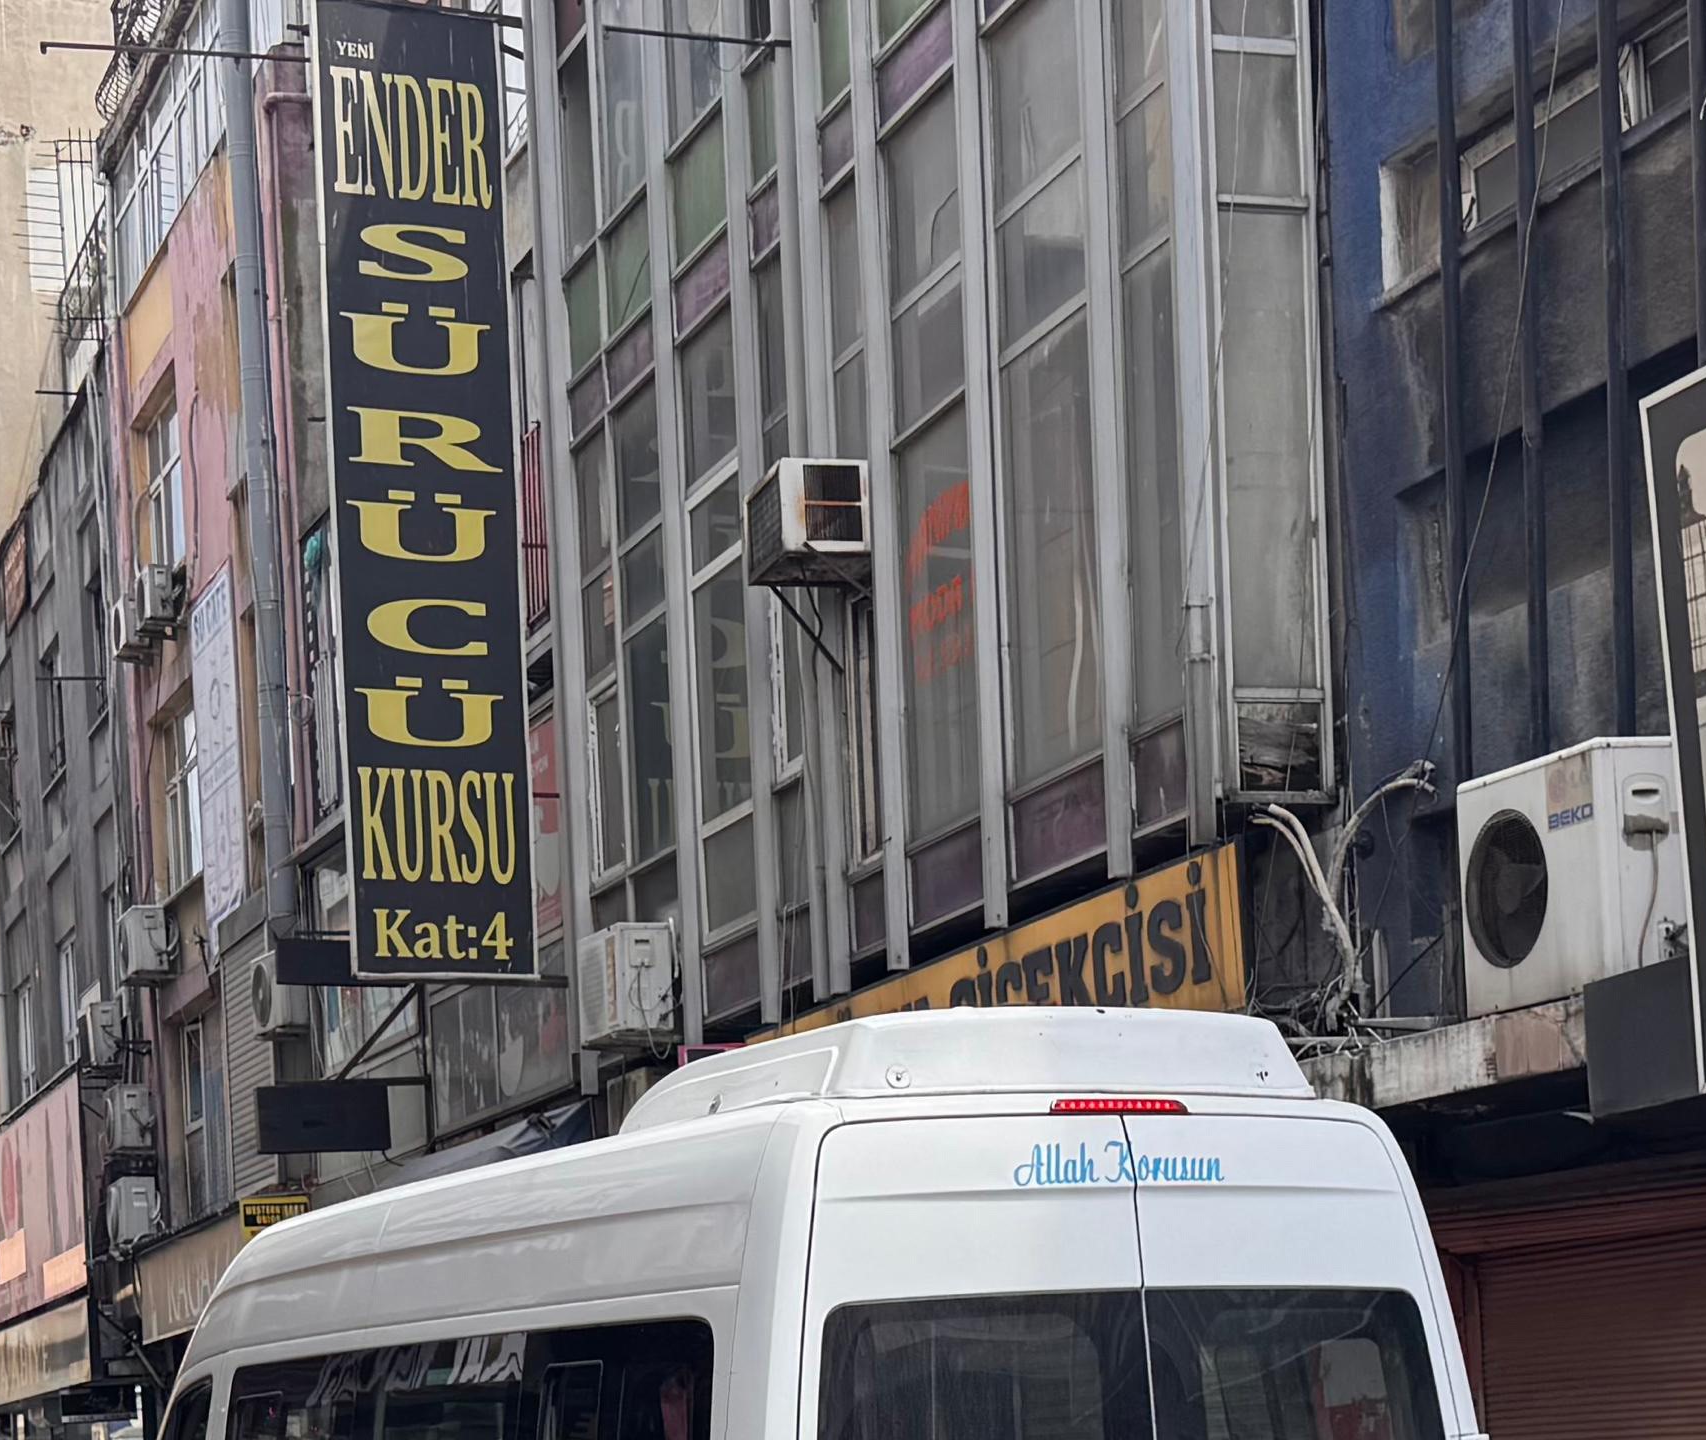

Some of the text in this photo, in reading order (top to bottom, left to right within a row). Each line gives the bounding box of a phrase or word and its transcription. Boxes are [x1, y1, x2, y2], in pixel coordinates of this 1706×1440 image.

[336, 38, 375, 60] YENİ
[330, 65, 493, 210] ENDER
[339, 223, 504, 747] SÜRÜCÜ
[357, 766, 516, 885] KURSU
[1548, 803, 1593, 830] BEKO
[373, 907, 514, 961] Kat:4
[1014, 1142, 1099, 1187] Allah
